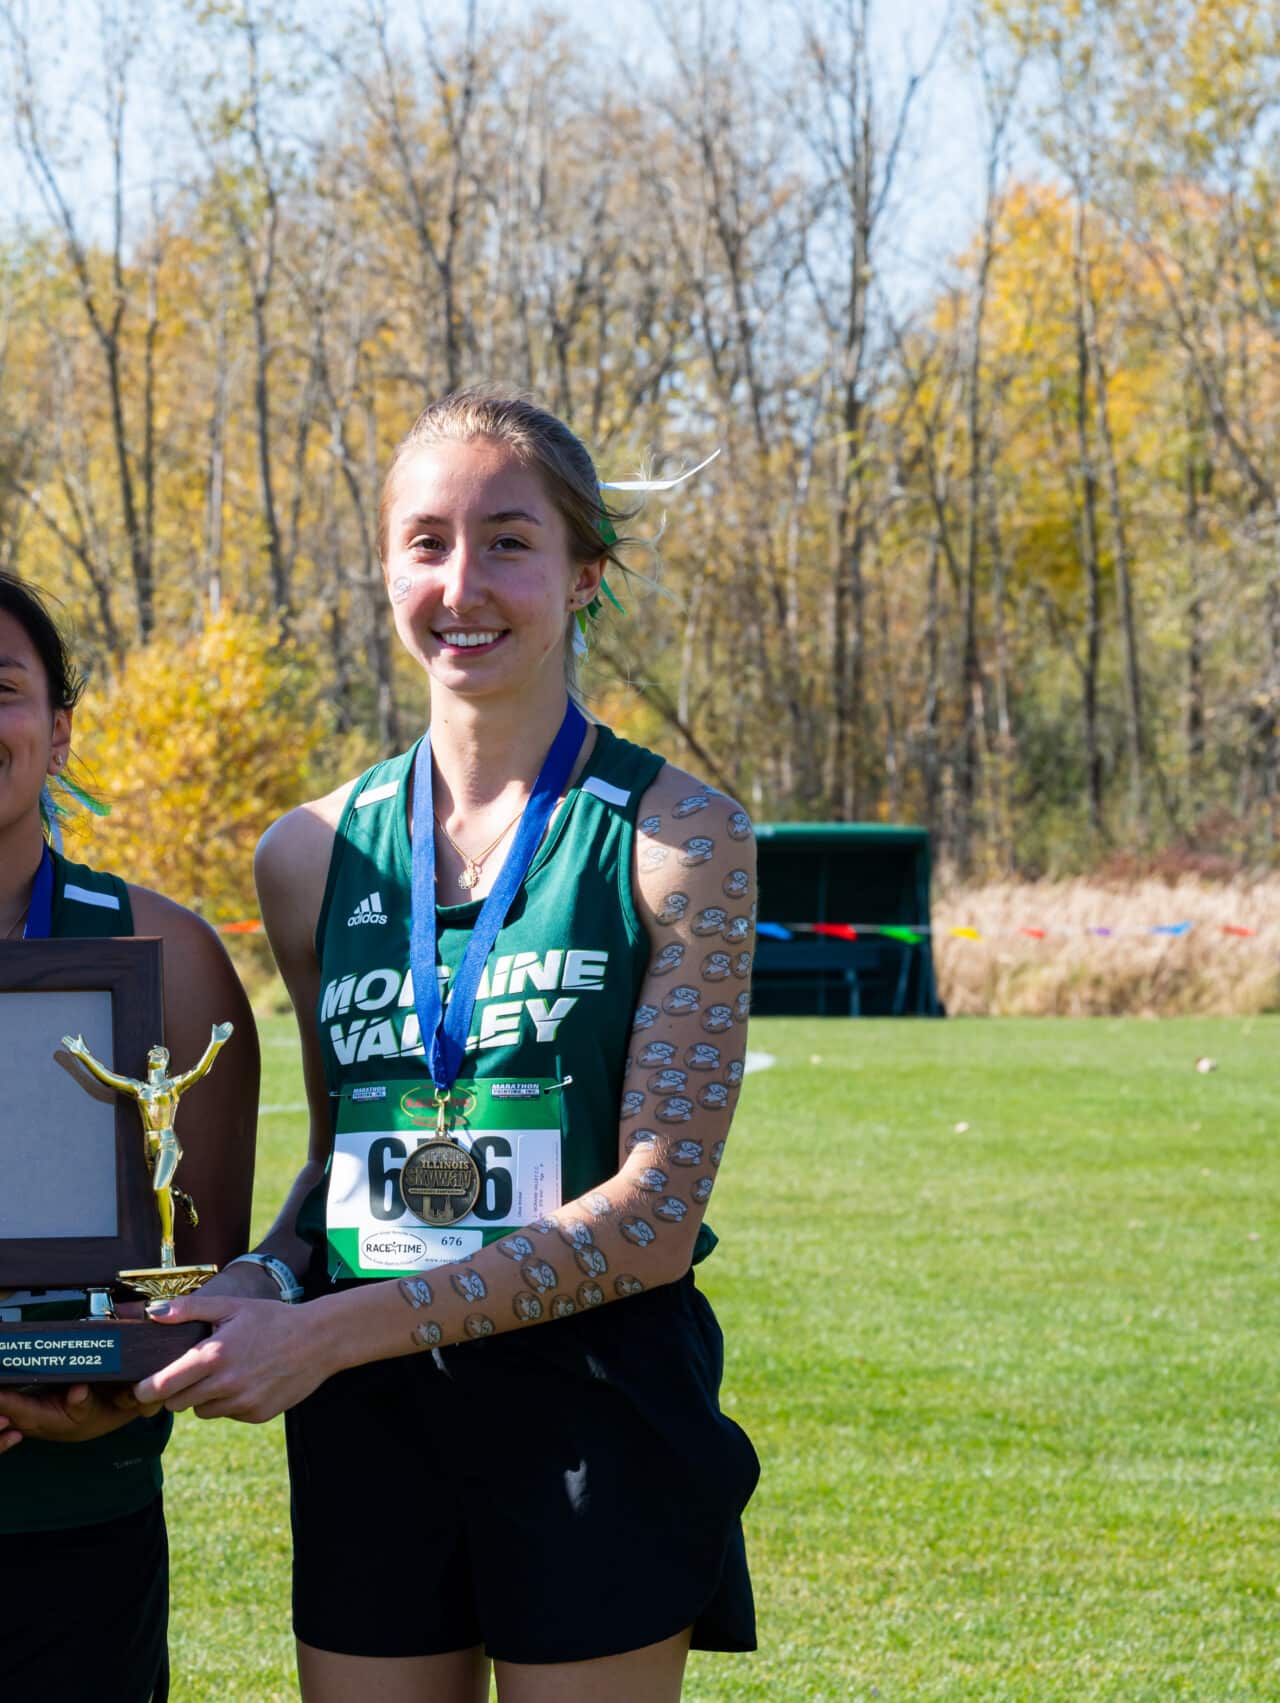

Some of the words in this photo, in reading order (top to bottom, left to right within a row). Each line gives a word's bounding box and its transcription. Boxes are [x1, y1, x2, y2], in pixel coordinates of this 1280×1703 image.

[347, 911, 388, 927] adidas
[330, 996, 580, 1066] VALEY
[421, 1160, 469, 1169] ILLINOIS
[368, 1136, 513, 1221] 66
[441, 1236, 463, 1247] 676
[366, 1243, 390, 1253] RACE
[397, 1244, 422, 1254] TIME
[34, 1338, 115, 1350] CONFERENCE
[3, 1355, 67, 1367] COUNTRY
[68, 1354, 102, 1366] 2022
